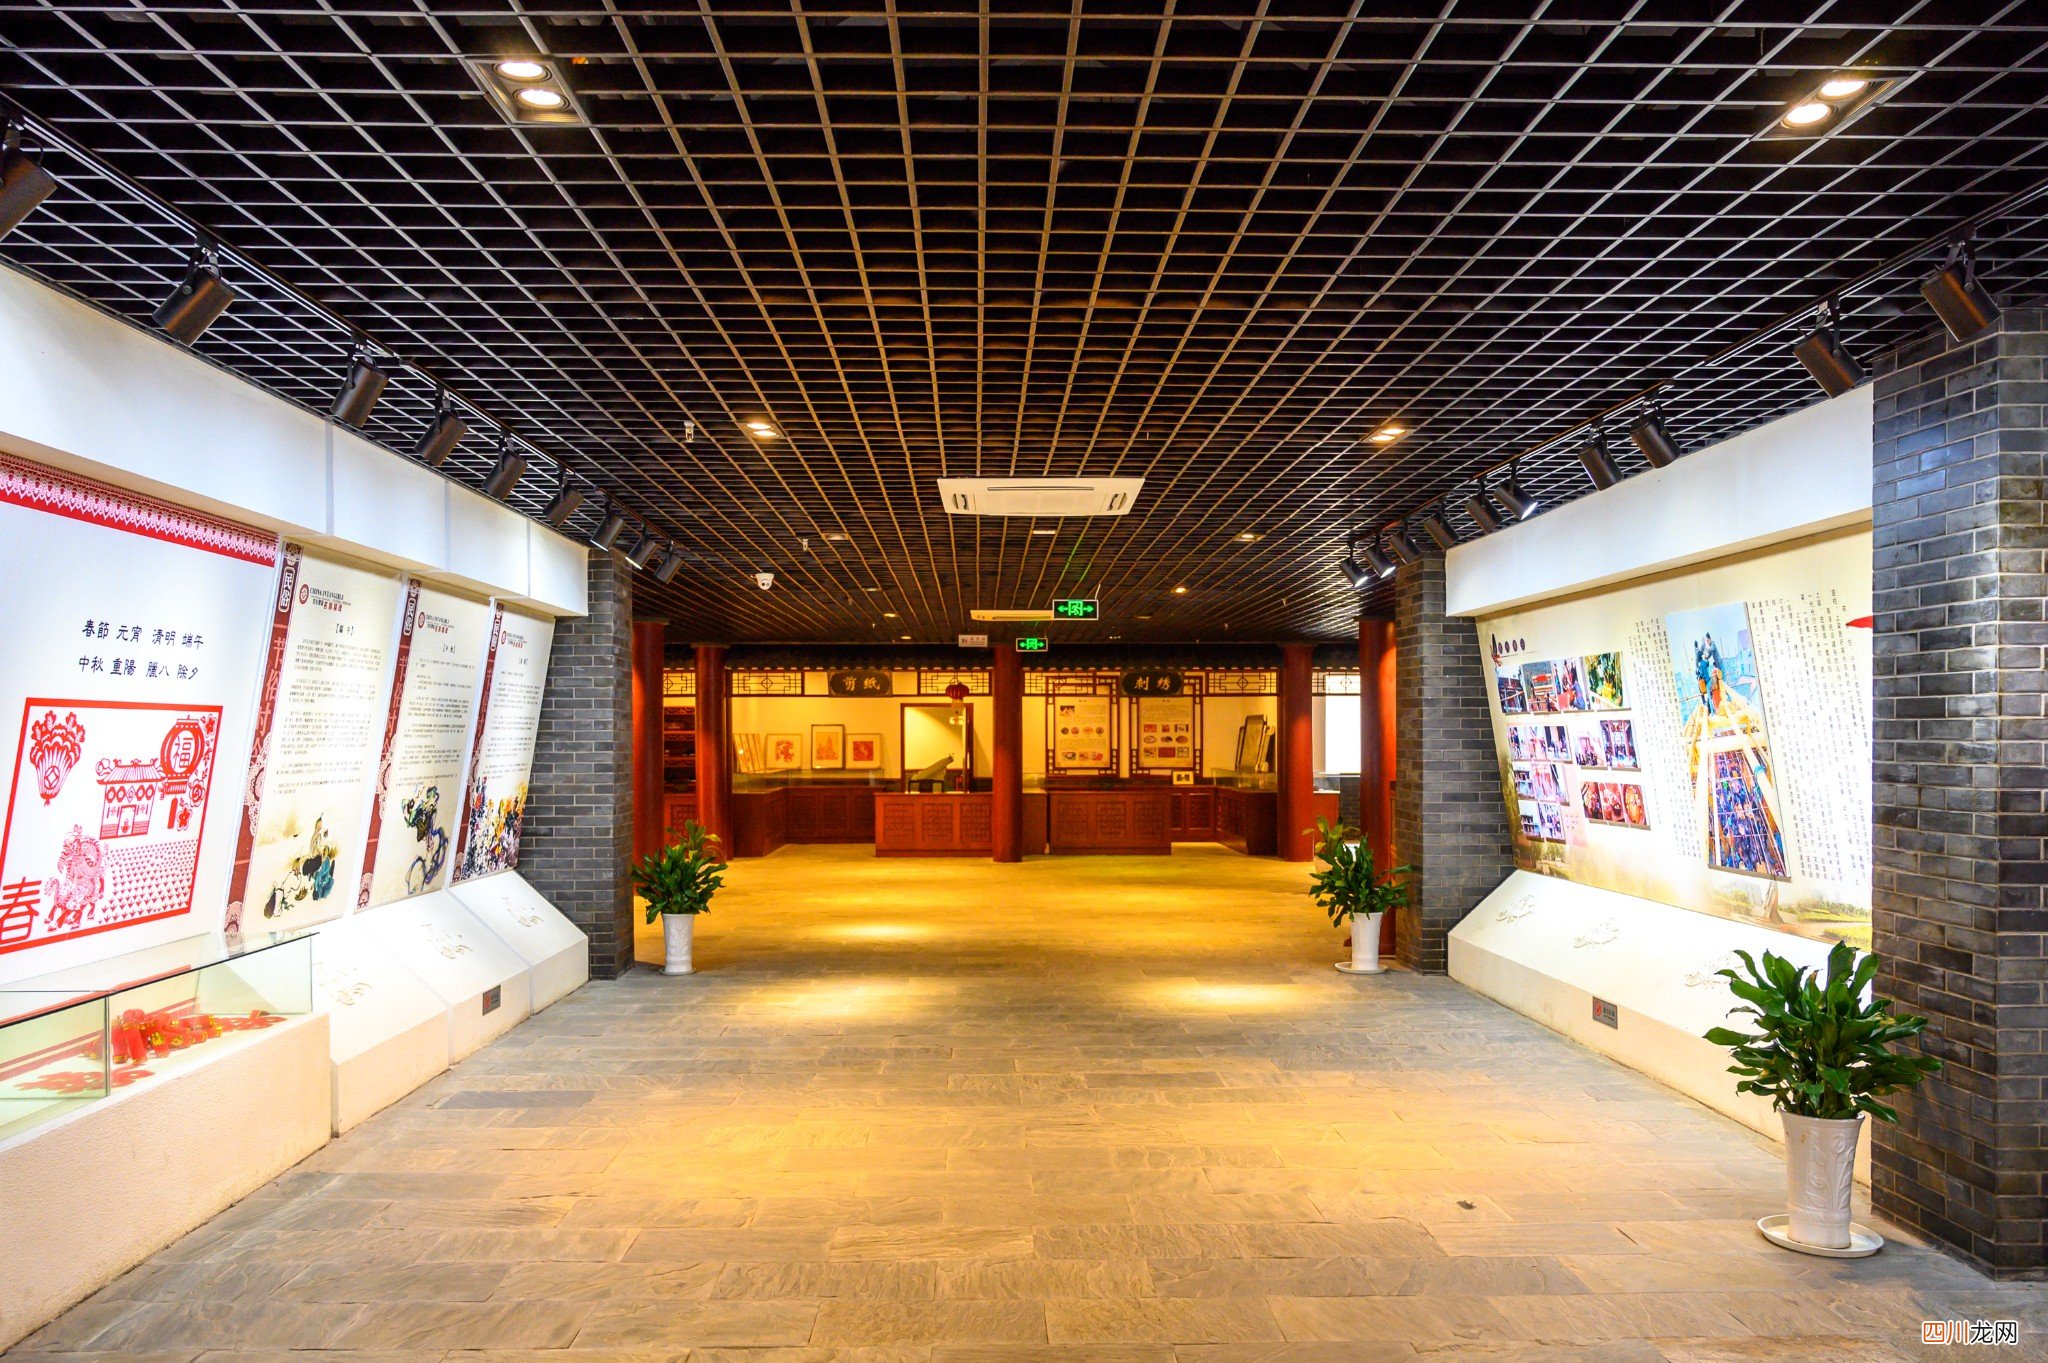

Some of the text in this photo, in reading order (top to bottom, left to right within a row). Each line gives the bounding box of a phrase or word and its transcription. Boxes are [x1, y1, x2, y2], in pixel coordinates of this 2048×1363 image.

[82, 619, 204, 650] 春節 元宵 清明 端午
[79, 655, 104, 673] 中秋
[110, 658, 136, 676] 重陽
[177, 664, 198, 680] 除夕
[843, 676, 880, 691] 剪纸
[1134, 676, 1170, 691] 刺绣
[174, 736, 194, 769] 福
[0, 876, 42, 944] 春
